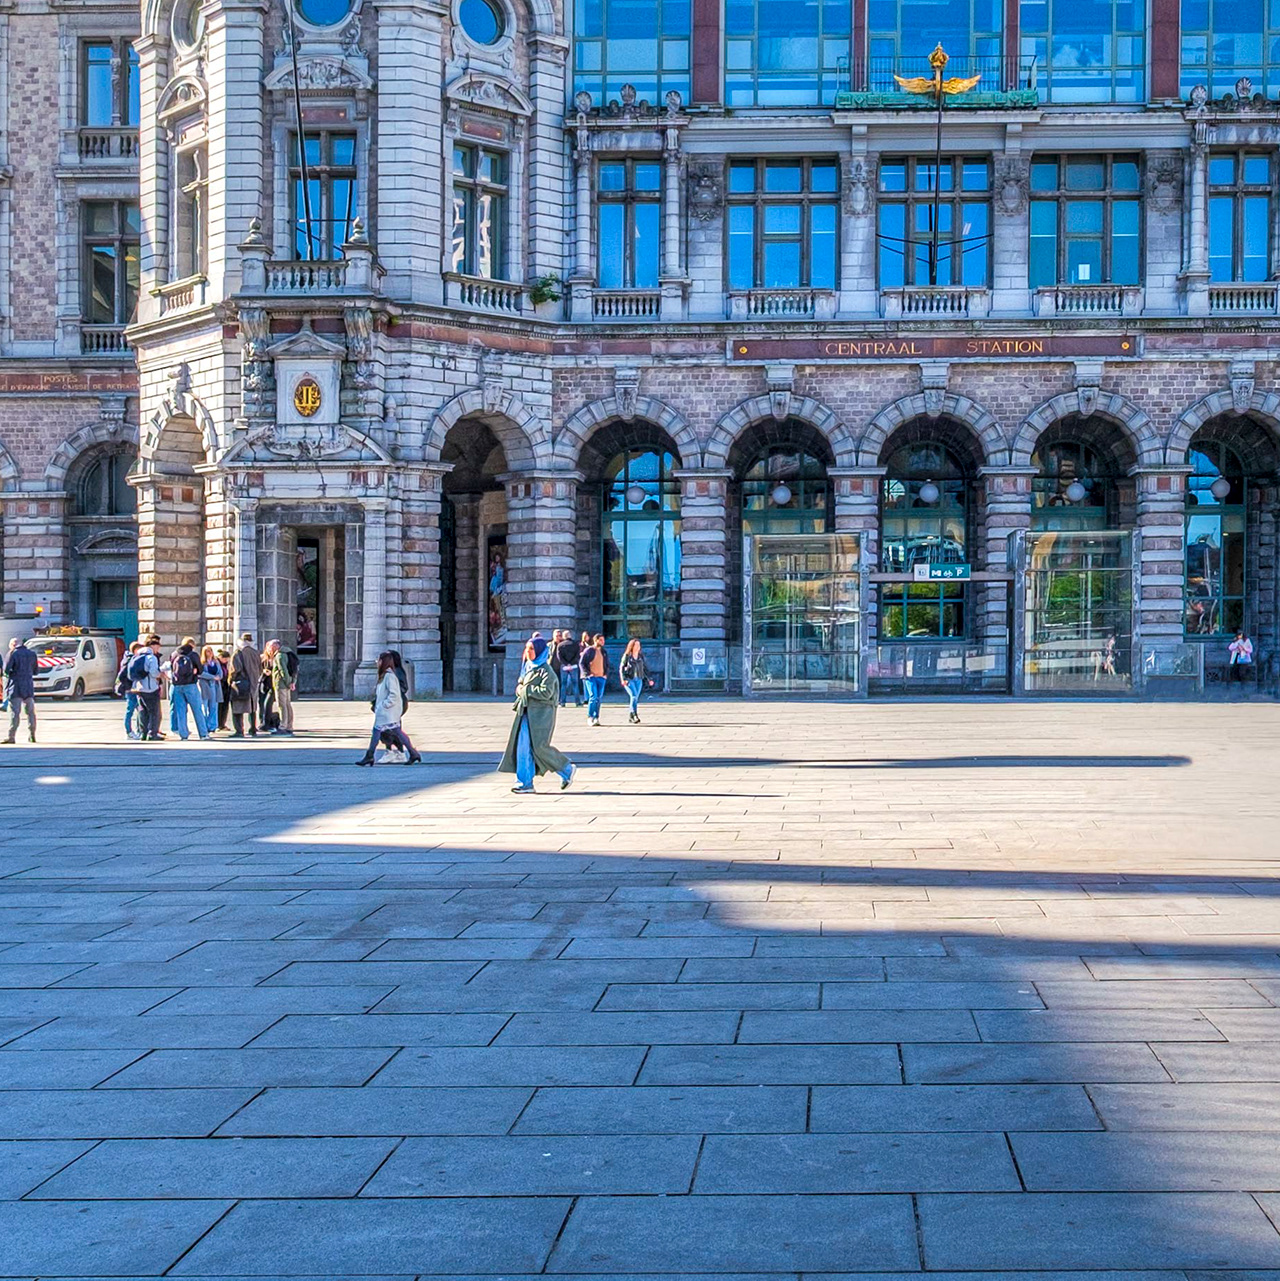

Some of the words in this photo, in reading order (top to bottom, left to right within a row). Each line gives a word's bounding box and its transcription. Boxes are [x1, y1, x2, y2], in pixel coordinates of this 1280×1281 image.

[825, 342, 923, 355] CENTRAAL
[966, 340, 1043, 354] STATION
[44, 375, 78, 383] POSTES
